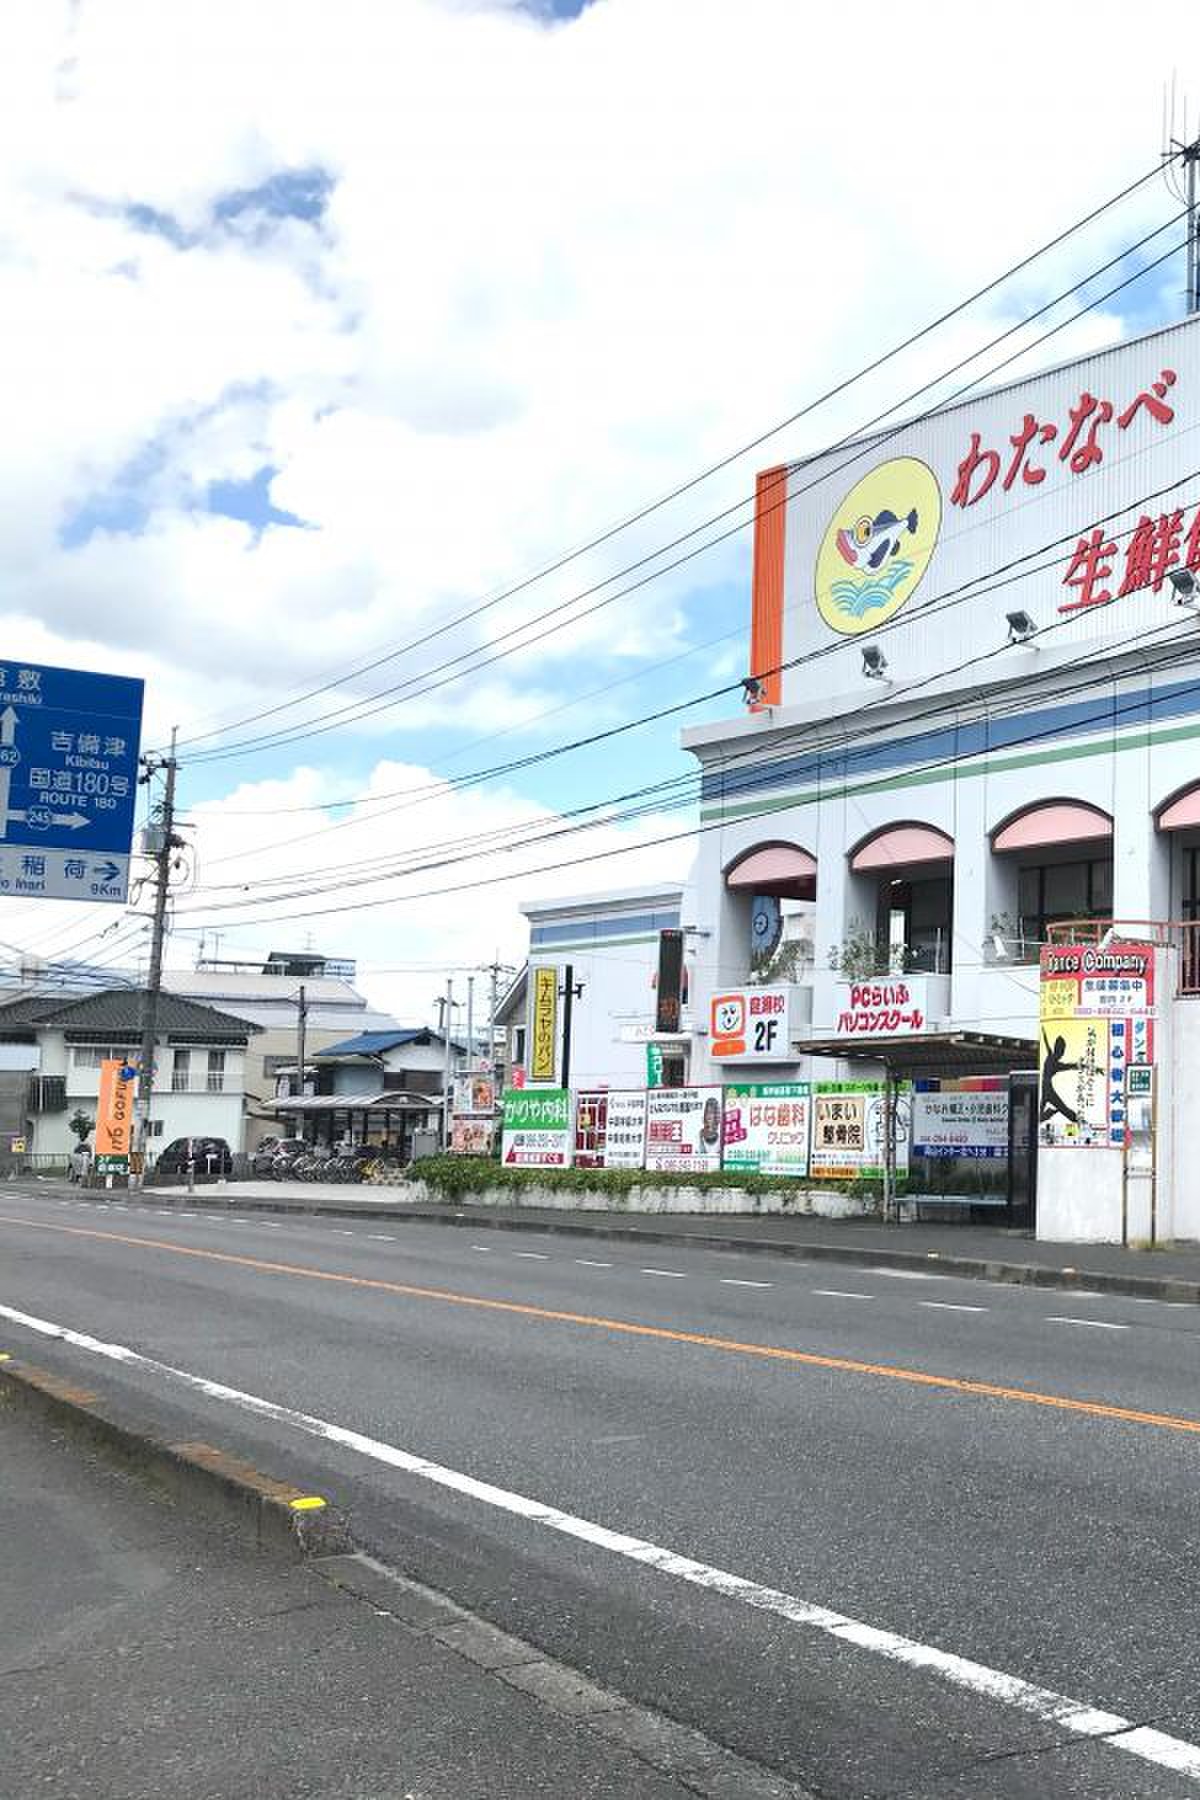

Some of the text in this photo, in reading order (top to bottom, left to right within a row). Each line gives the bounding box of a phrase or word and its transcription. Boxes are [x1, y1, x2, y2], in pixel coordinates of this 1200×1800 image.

[950, 368, 1178, 509] わたなべ
[50, 731, 127, 757] 吉備津
[65, 754, 110, 770] Kibitsu
[30, 767, 130, 798] 国道180号
[40, 791, 118, 810] ROUTE 180
[90, 883, 122, 897] 9Km
[1083, 949, 1146, 976] Company
[850, 983, 910, 1010] PCらいふ
[836, 1009, 925, 1034] パソコンスクール
[754, 1020, 779, 1053] 2F
[823, 1124, 861, 1145] 整骨院
